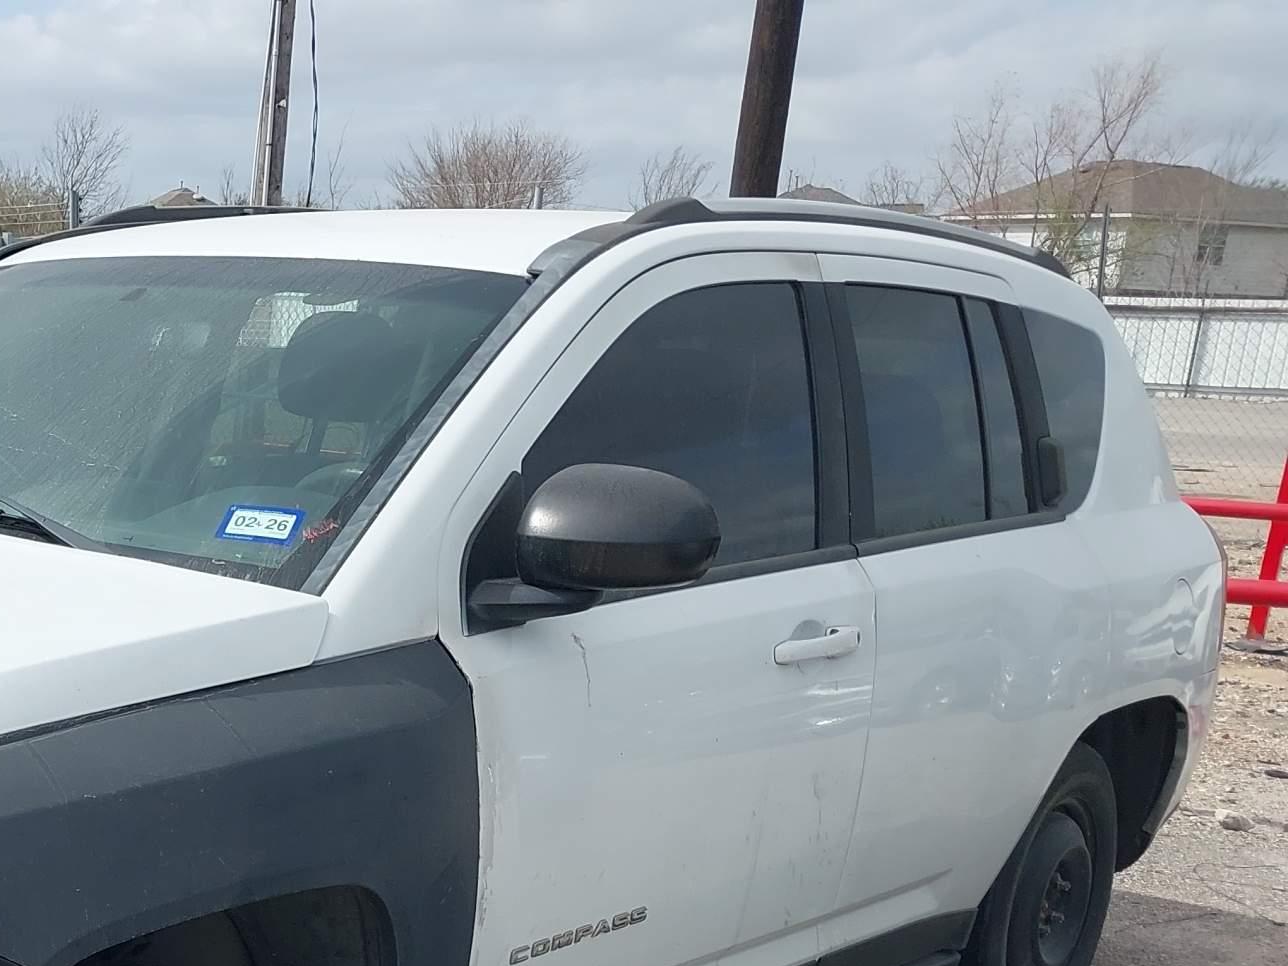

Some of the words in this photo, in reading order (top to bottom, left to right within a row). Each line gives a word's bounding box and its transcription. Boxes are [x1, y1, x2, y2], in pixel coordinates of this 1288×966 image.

[234, 515, 258, 528] 02
[264, 518, 289, 532] 26
[509, 905, 648, 966] COMPASS
